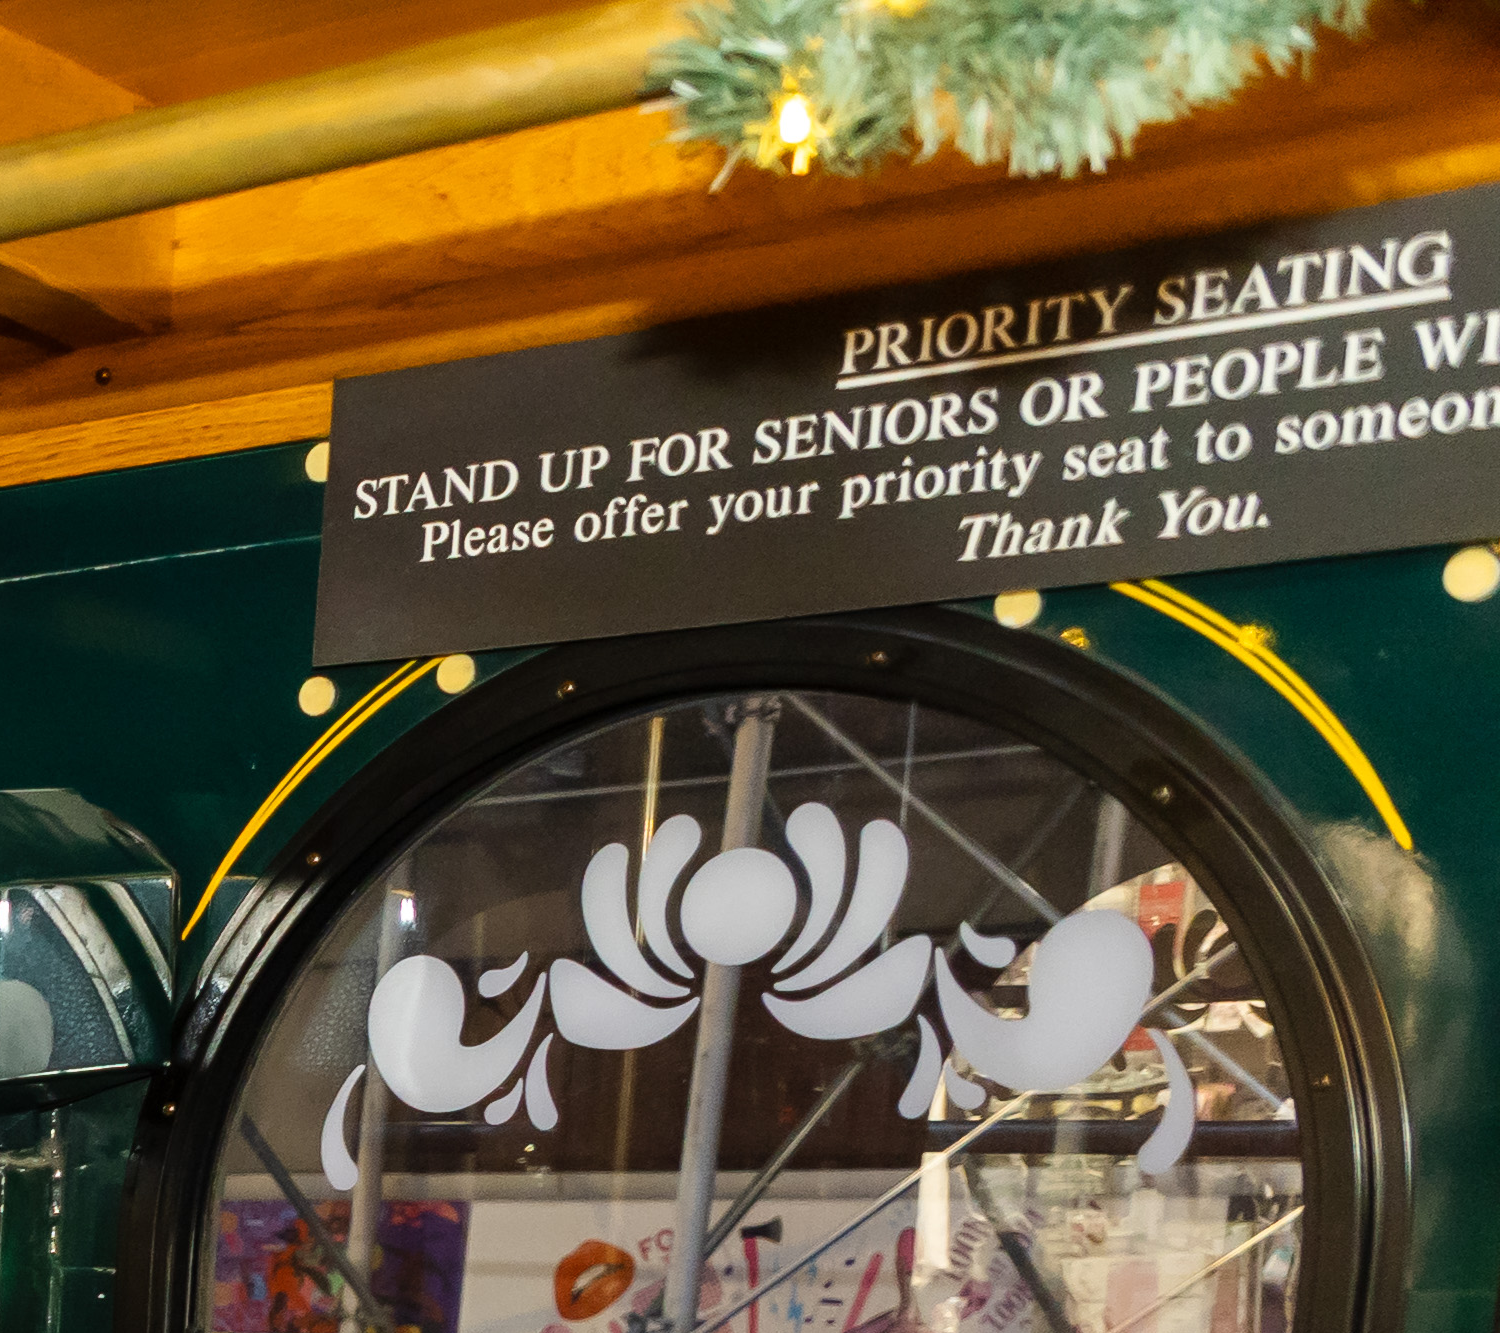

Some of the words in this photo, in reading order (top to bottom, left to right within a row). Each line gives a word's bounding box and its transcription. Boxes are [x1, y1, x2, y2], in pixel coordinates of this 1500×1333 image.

[838, 284, 1134, 376] PRIORITY
[1153, 230, 1452, 326] SEATING
[354, 459, 519, 520] STAND
[539, 445, 610, 493] UP
[627, 427, 733, 483] FOR
[751, 386, 1000, 466] SENIORS
[1019, 370, 1106, 427] OR
[1132, 328, 1385, 412] PEOPLE
[420, 515, 554, 562] Please
[574, 495, 689, 543] offer
[706, 482, 819, 534] your
[838, 446, 1042, 519] priority
[1062, 427, 1171, 483] seat
[1195, 421, 1253, 464] to
[957, 497, 1132, 562] Thank
[1158, 486, 1270, 540] You.
